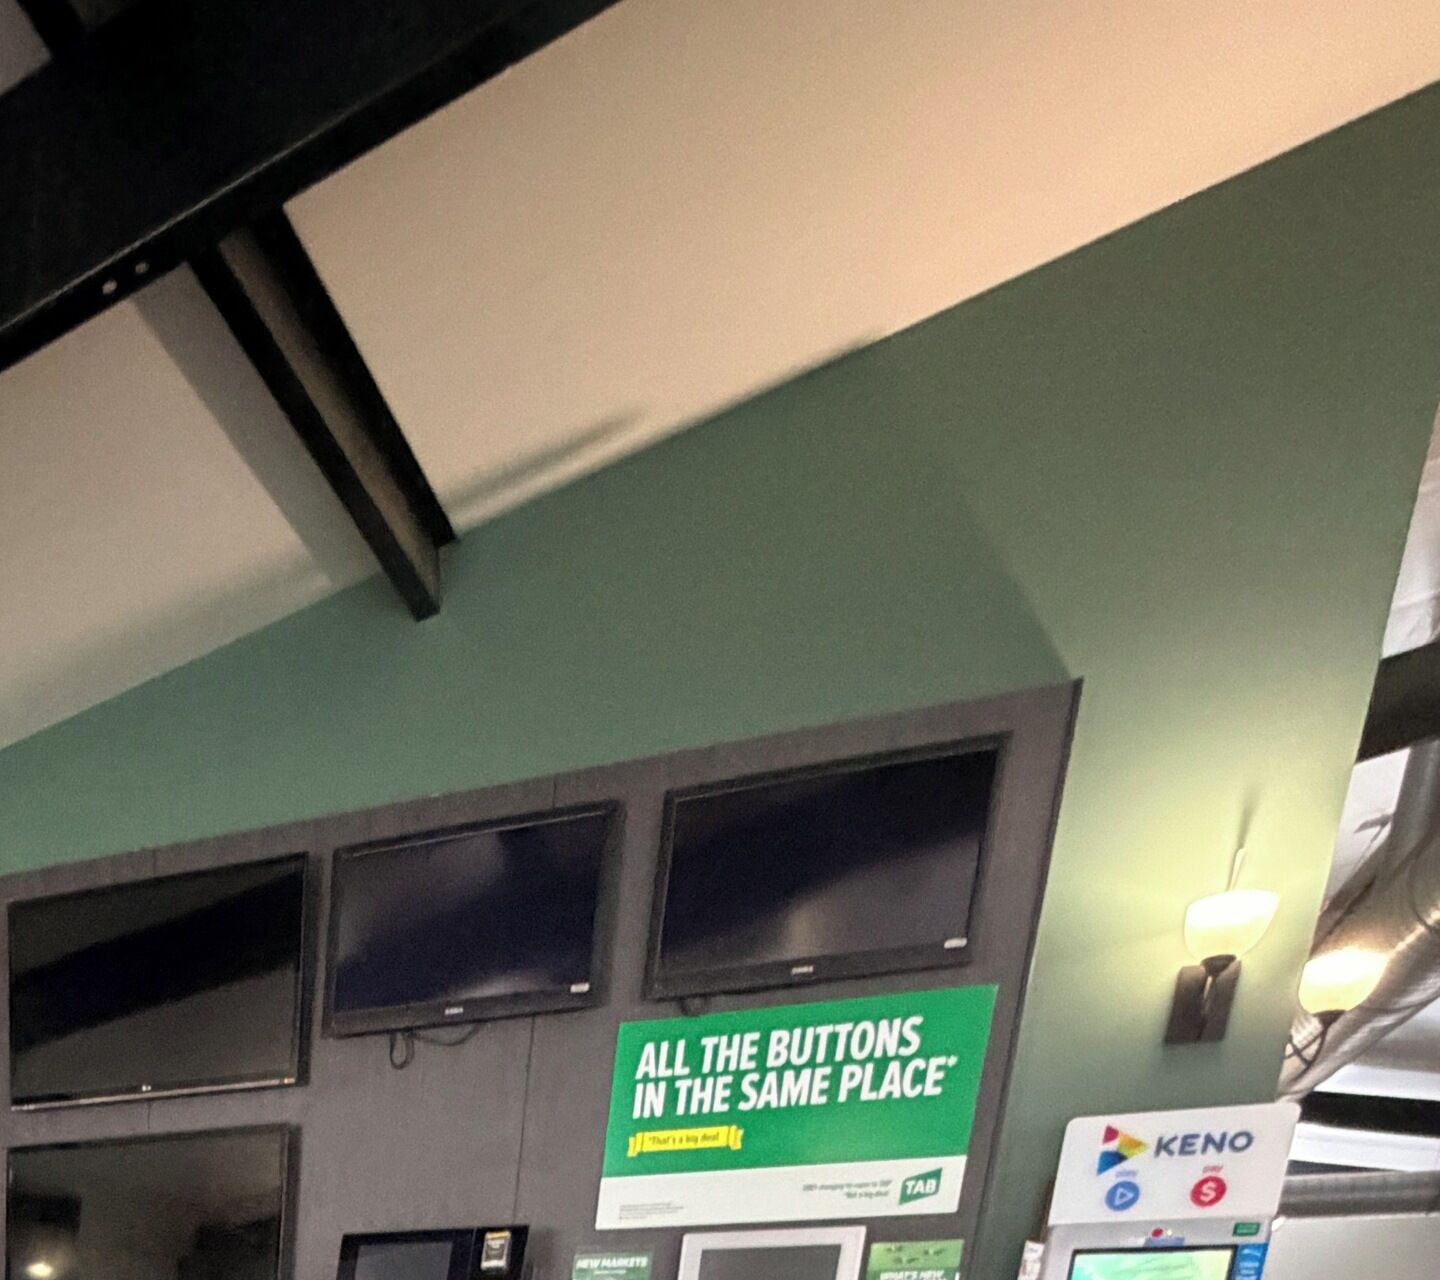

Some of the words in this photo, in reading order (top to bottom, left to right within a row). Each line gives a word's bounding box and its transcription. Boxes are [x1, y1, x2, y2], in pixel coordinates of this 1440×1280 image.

[635, 1038, 690, 1079] ALL
[700, 1031, 760, 1073] THE
[766, 1015, 924, 1068] BUTTONS
[632, 1079, 666, 1119] IN
[675, 1074, 730, 1116] THE
[737, 1064, 830, 1111] SAME
[1154, 1130, 1254, 1159] KENO
[905, 1179, 937, 1196] TAB
[576, 1258, 600, 1269] NEW
